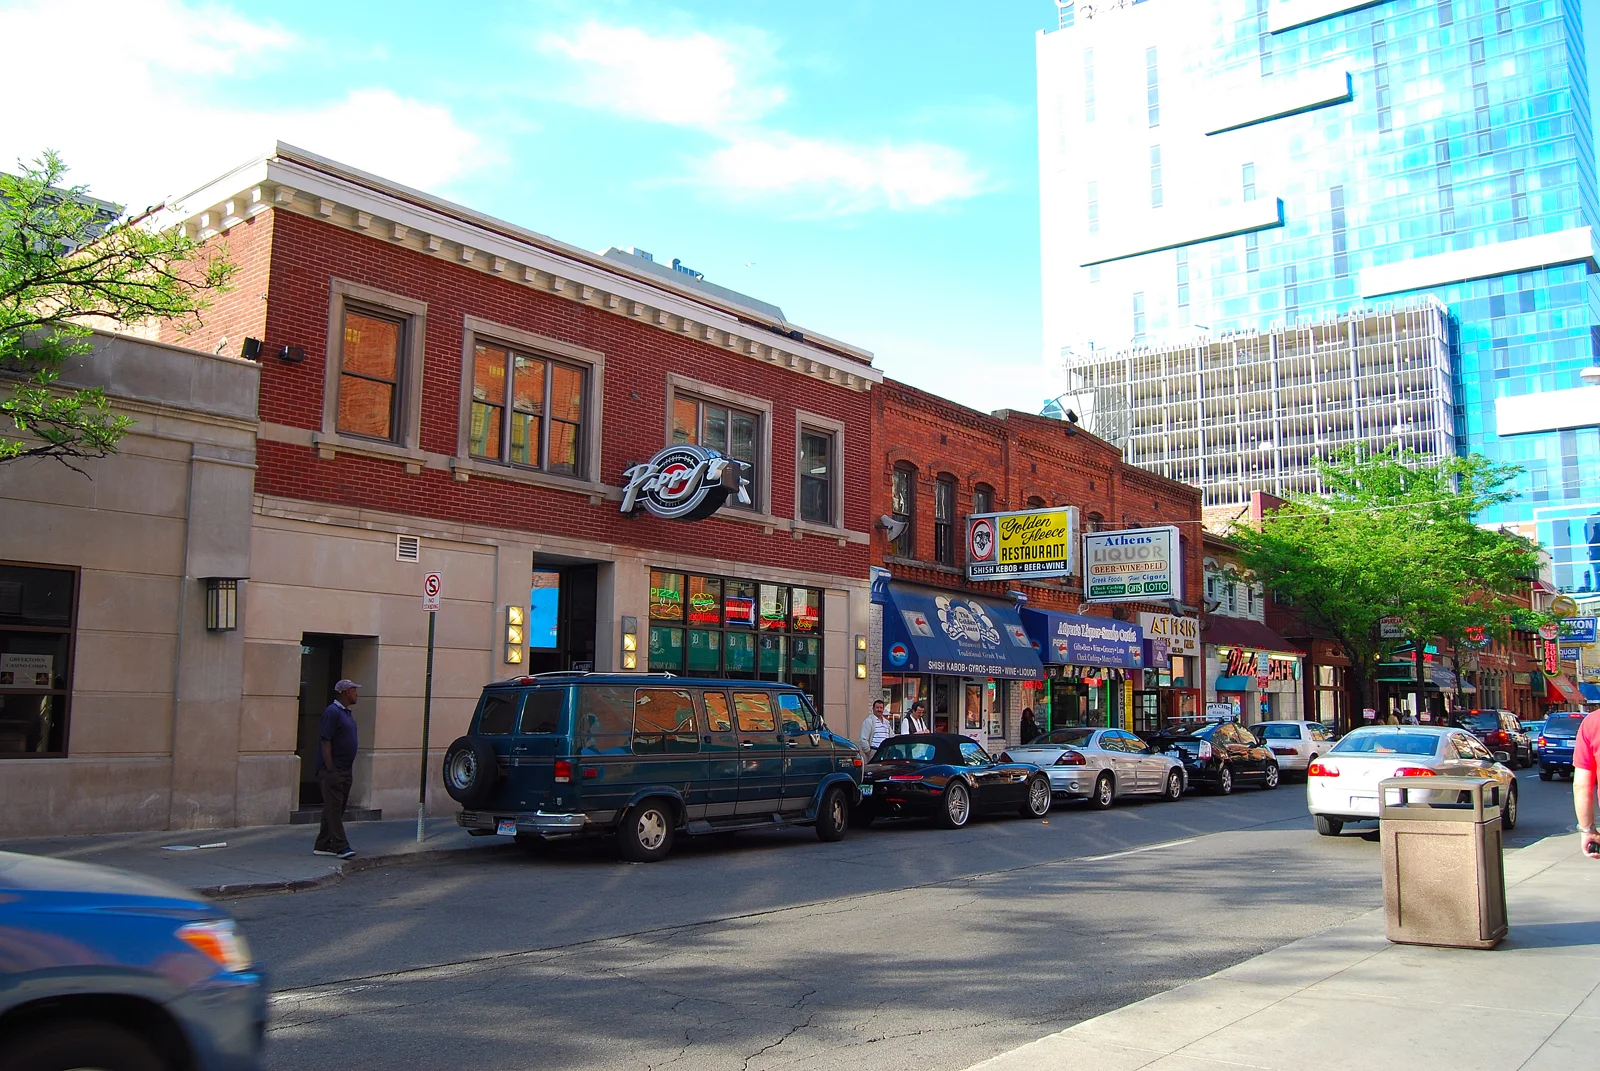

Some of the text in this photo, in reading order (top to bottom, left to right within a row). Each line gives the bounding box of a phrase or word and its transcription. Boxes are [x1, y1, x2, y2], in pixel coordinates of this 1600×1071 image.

[620, 457, 729, 513] Pappy's
[1001, 515, 1051, 540] Golden
[1021, 527, 1066, 545] Fleece
[1104, 535, 1152, 546] Athens
[1001, 543, 1065, 561] RESTAURANT
[1094, 545, 1164, 562] LIQUOR
[973, 566, 994, 575] SHISH
[995, 564, 1018, 573] KEBOB
[650, 587, 681, 602] PIZZA
[1145, 582, 1167, 592] LOTTO
[1151, 616, 1197, 638] ATHENS
[928, 661, 1036, 677] SHISH KABOB GYROS BEER WINE LIQUOR
[1225, 648, 1258, 678] Plak
[1268, 660, 1293, 680] CAFE
